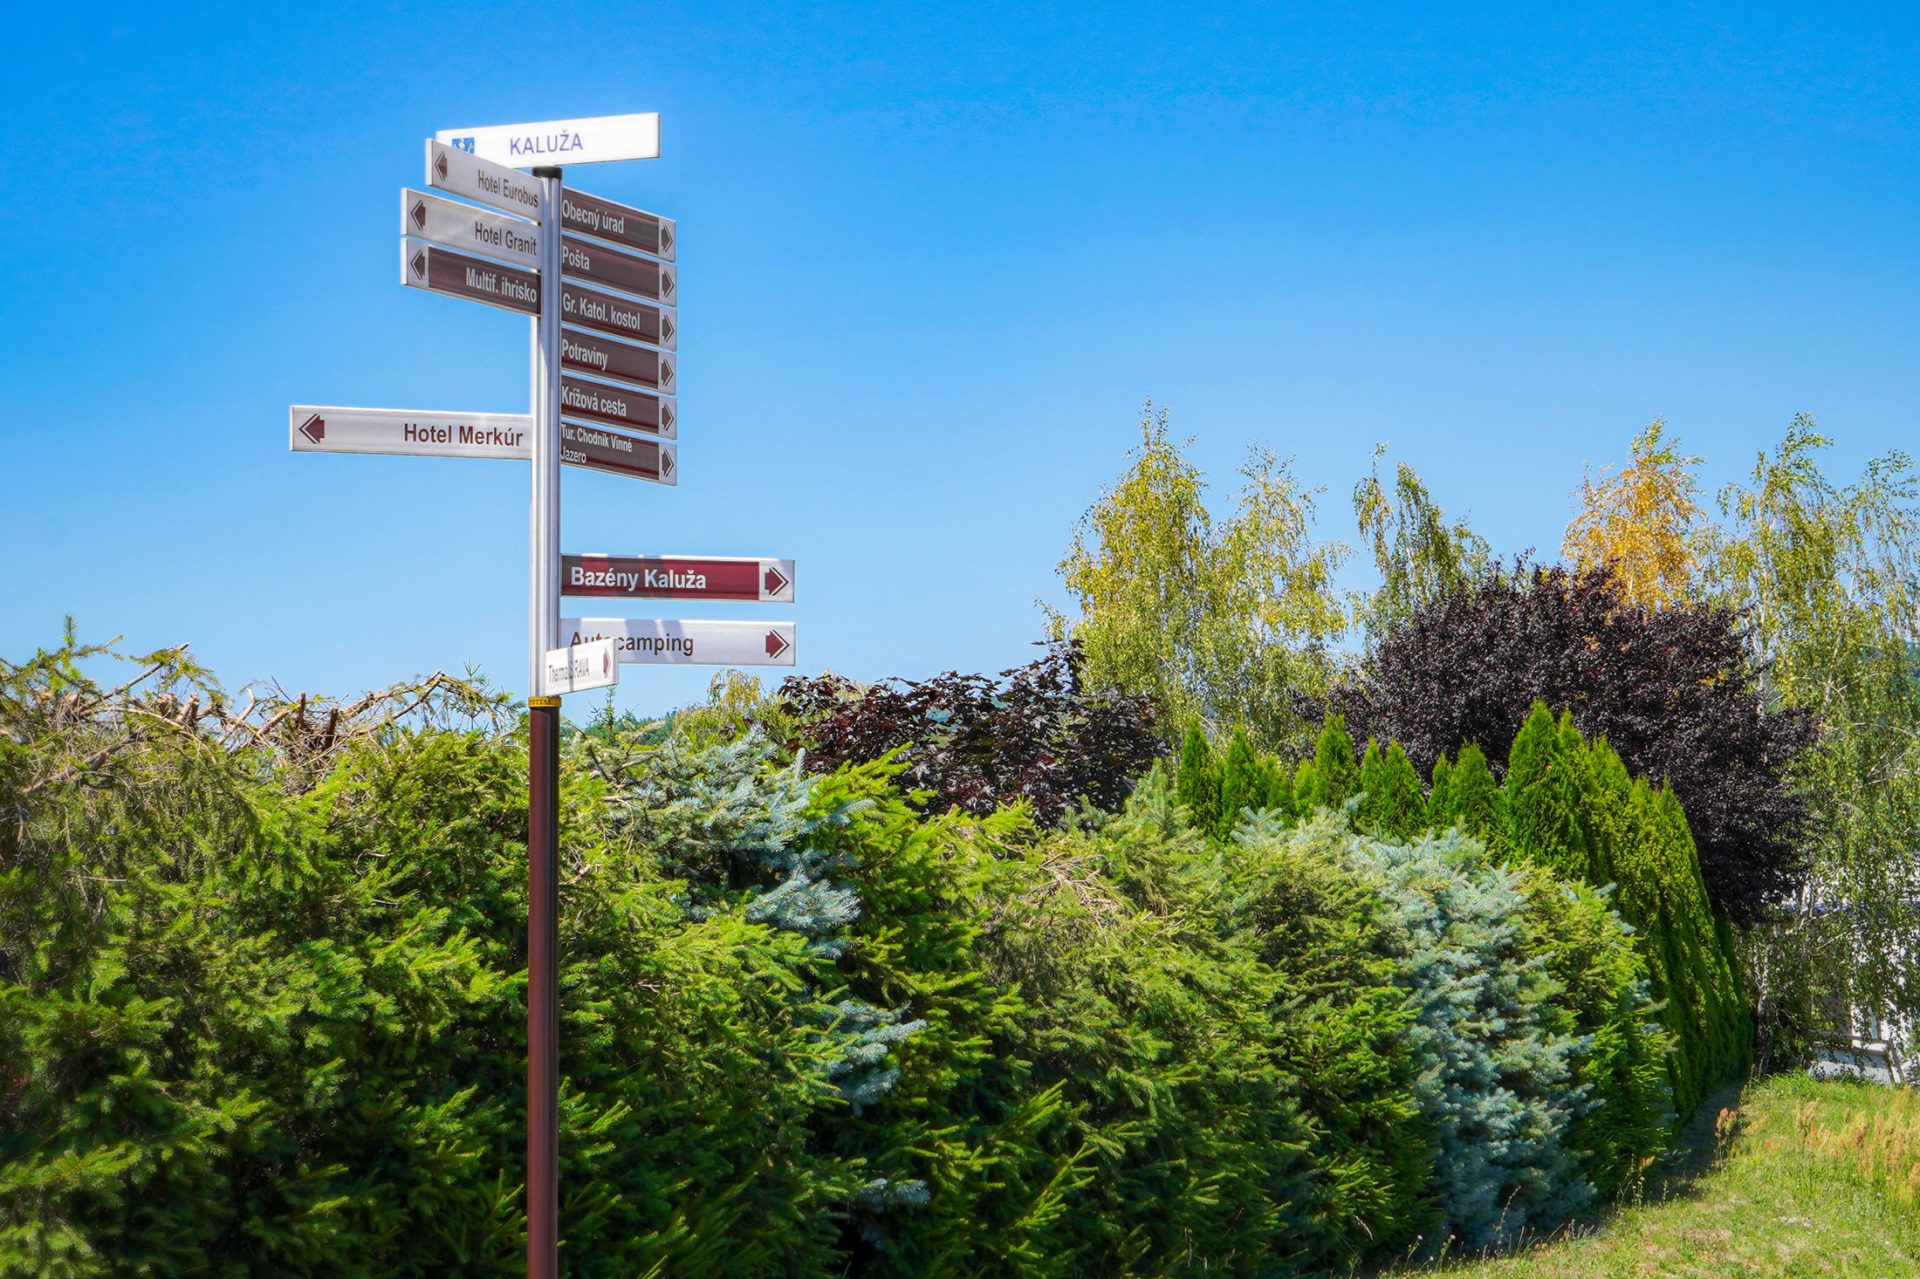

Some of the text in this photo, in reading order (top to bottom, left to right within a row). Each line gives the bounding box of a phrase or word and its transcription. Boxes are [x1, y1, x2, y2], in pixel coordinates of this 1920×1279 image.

[510, 129, 583, 155] KALUŽA
[477, 169, 539, 208] Hotel Eurobus
[562, 199, 625, 234] Obecný úrad
[475, 221, 537, 256] Hotel Granit
[562, 245, 590, 270] Pošta
[466, 267, 537, 303] Multif. ihrisko
[562, 292, 641, 330] Gr. Katol. kostol
[562, 338, 608, 371] Potraviny
[561, 385, 627, 417] Krížová cesta
[404, 423, 523, 447] Hotel Merkúr
[561, 424, 576, 438] Tur.
[611, 435, 633, 453] Vinné
[561, 446, 587, 464] Jazero
[571, 566, 706, 592] Bazény Kaluža
